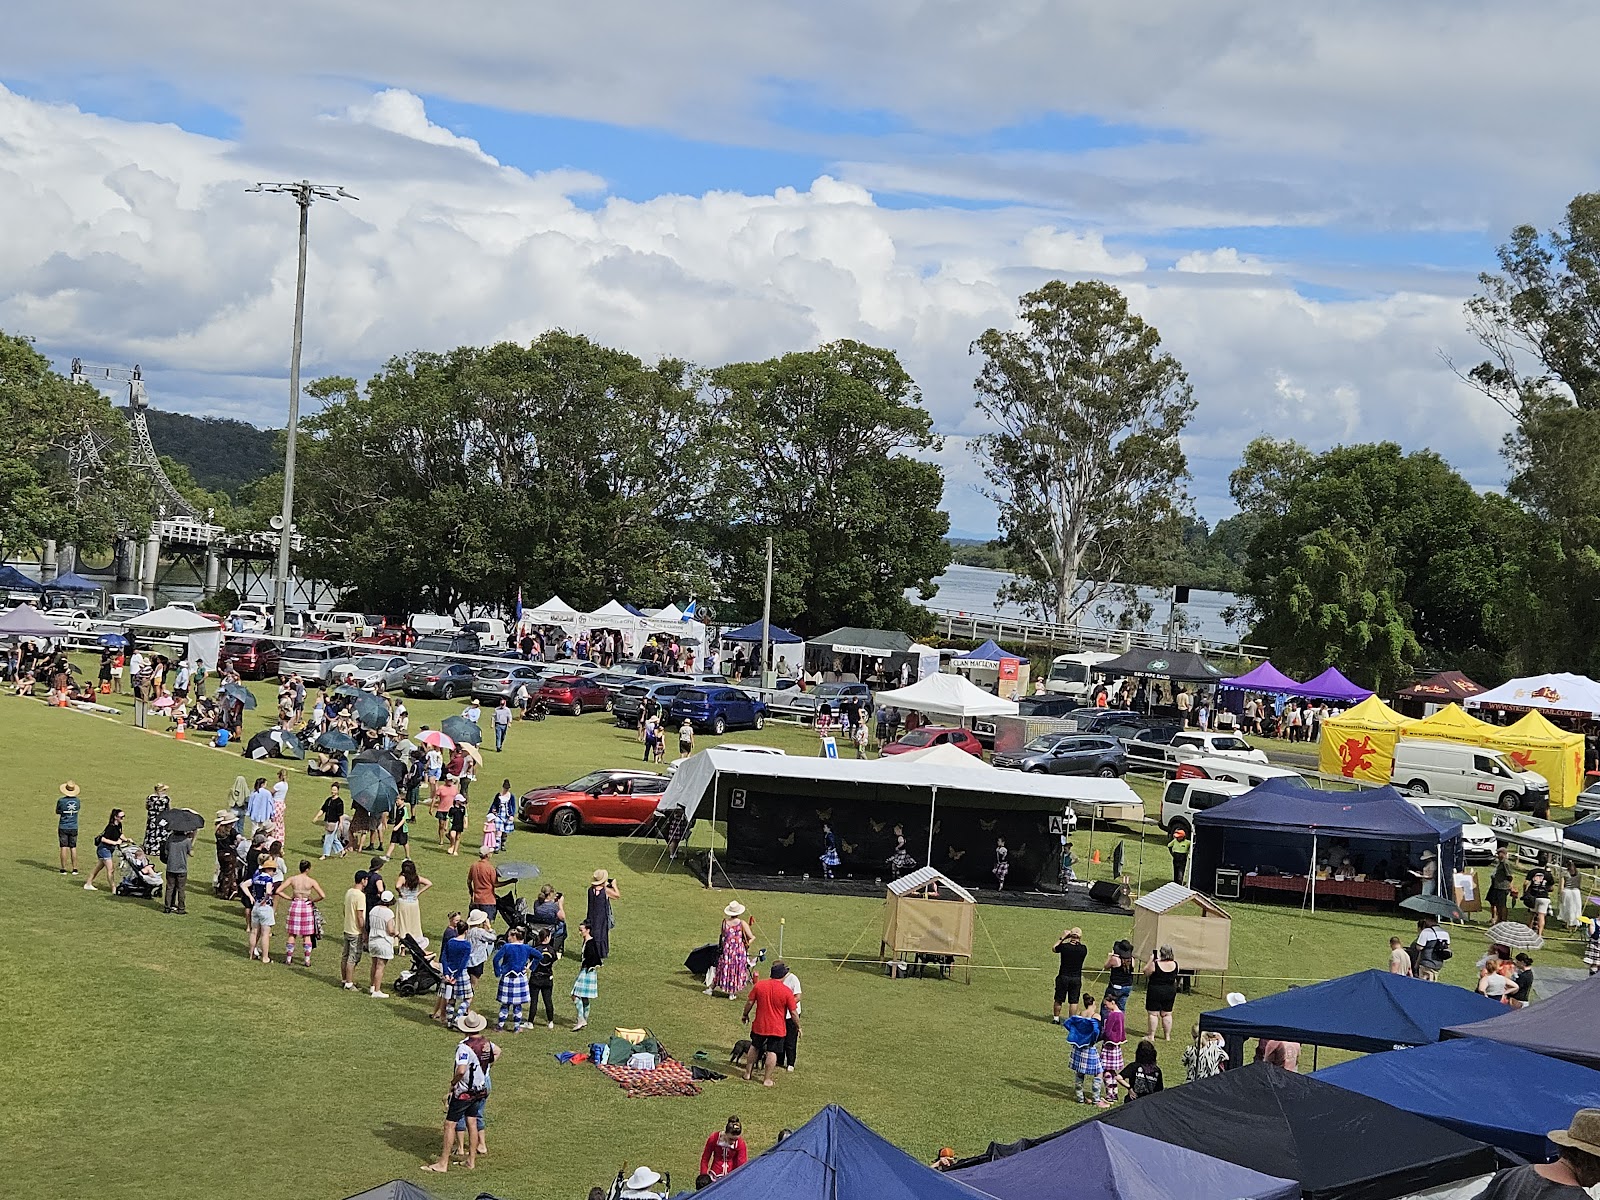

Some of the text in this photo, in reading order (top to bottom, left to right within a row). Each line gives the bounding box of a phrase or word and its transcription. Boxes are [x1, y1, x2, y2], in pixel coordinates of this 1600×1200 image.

[970, 661, 998, 669] MACLEAN
[733, 790, 745, 807] B
[1051, 817, 1062, 832] A
